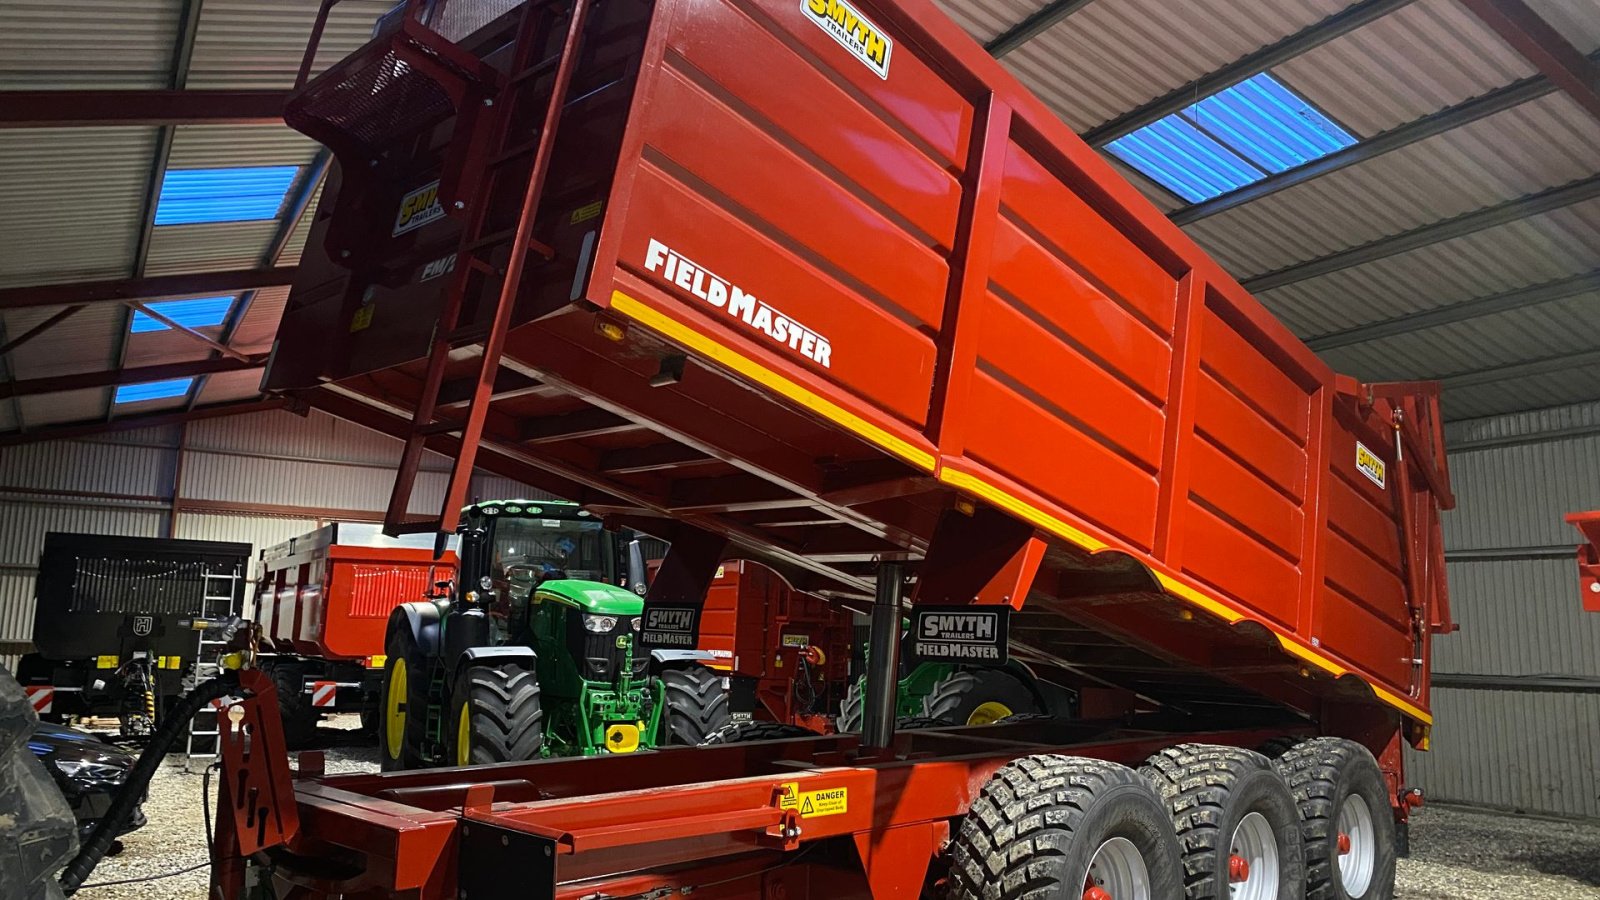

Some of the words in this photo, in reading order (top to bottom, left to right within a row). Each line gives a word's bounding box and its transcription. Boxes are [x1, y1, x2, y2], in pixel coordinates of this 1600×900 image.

[808, 0, 887, 69] SMYTH
[826, 19, 864, 55] TRAILERS
[648, 610, 692, 629] SMYTH
[924, 615, 993, 638] SMYTH
[816, 790, 845, 801] DANGER
